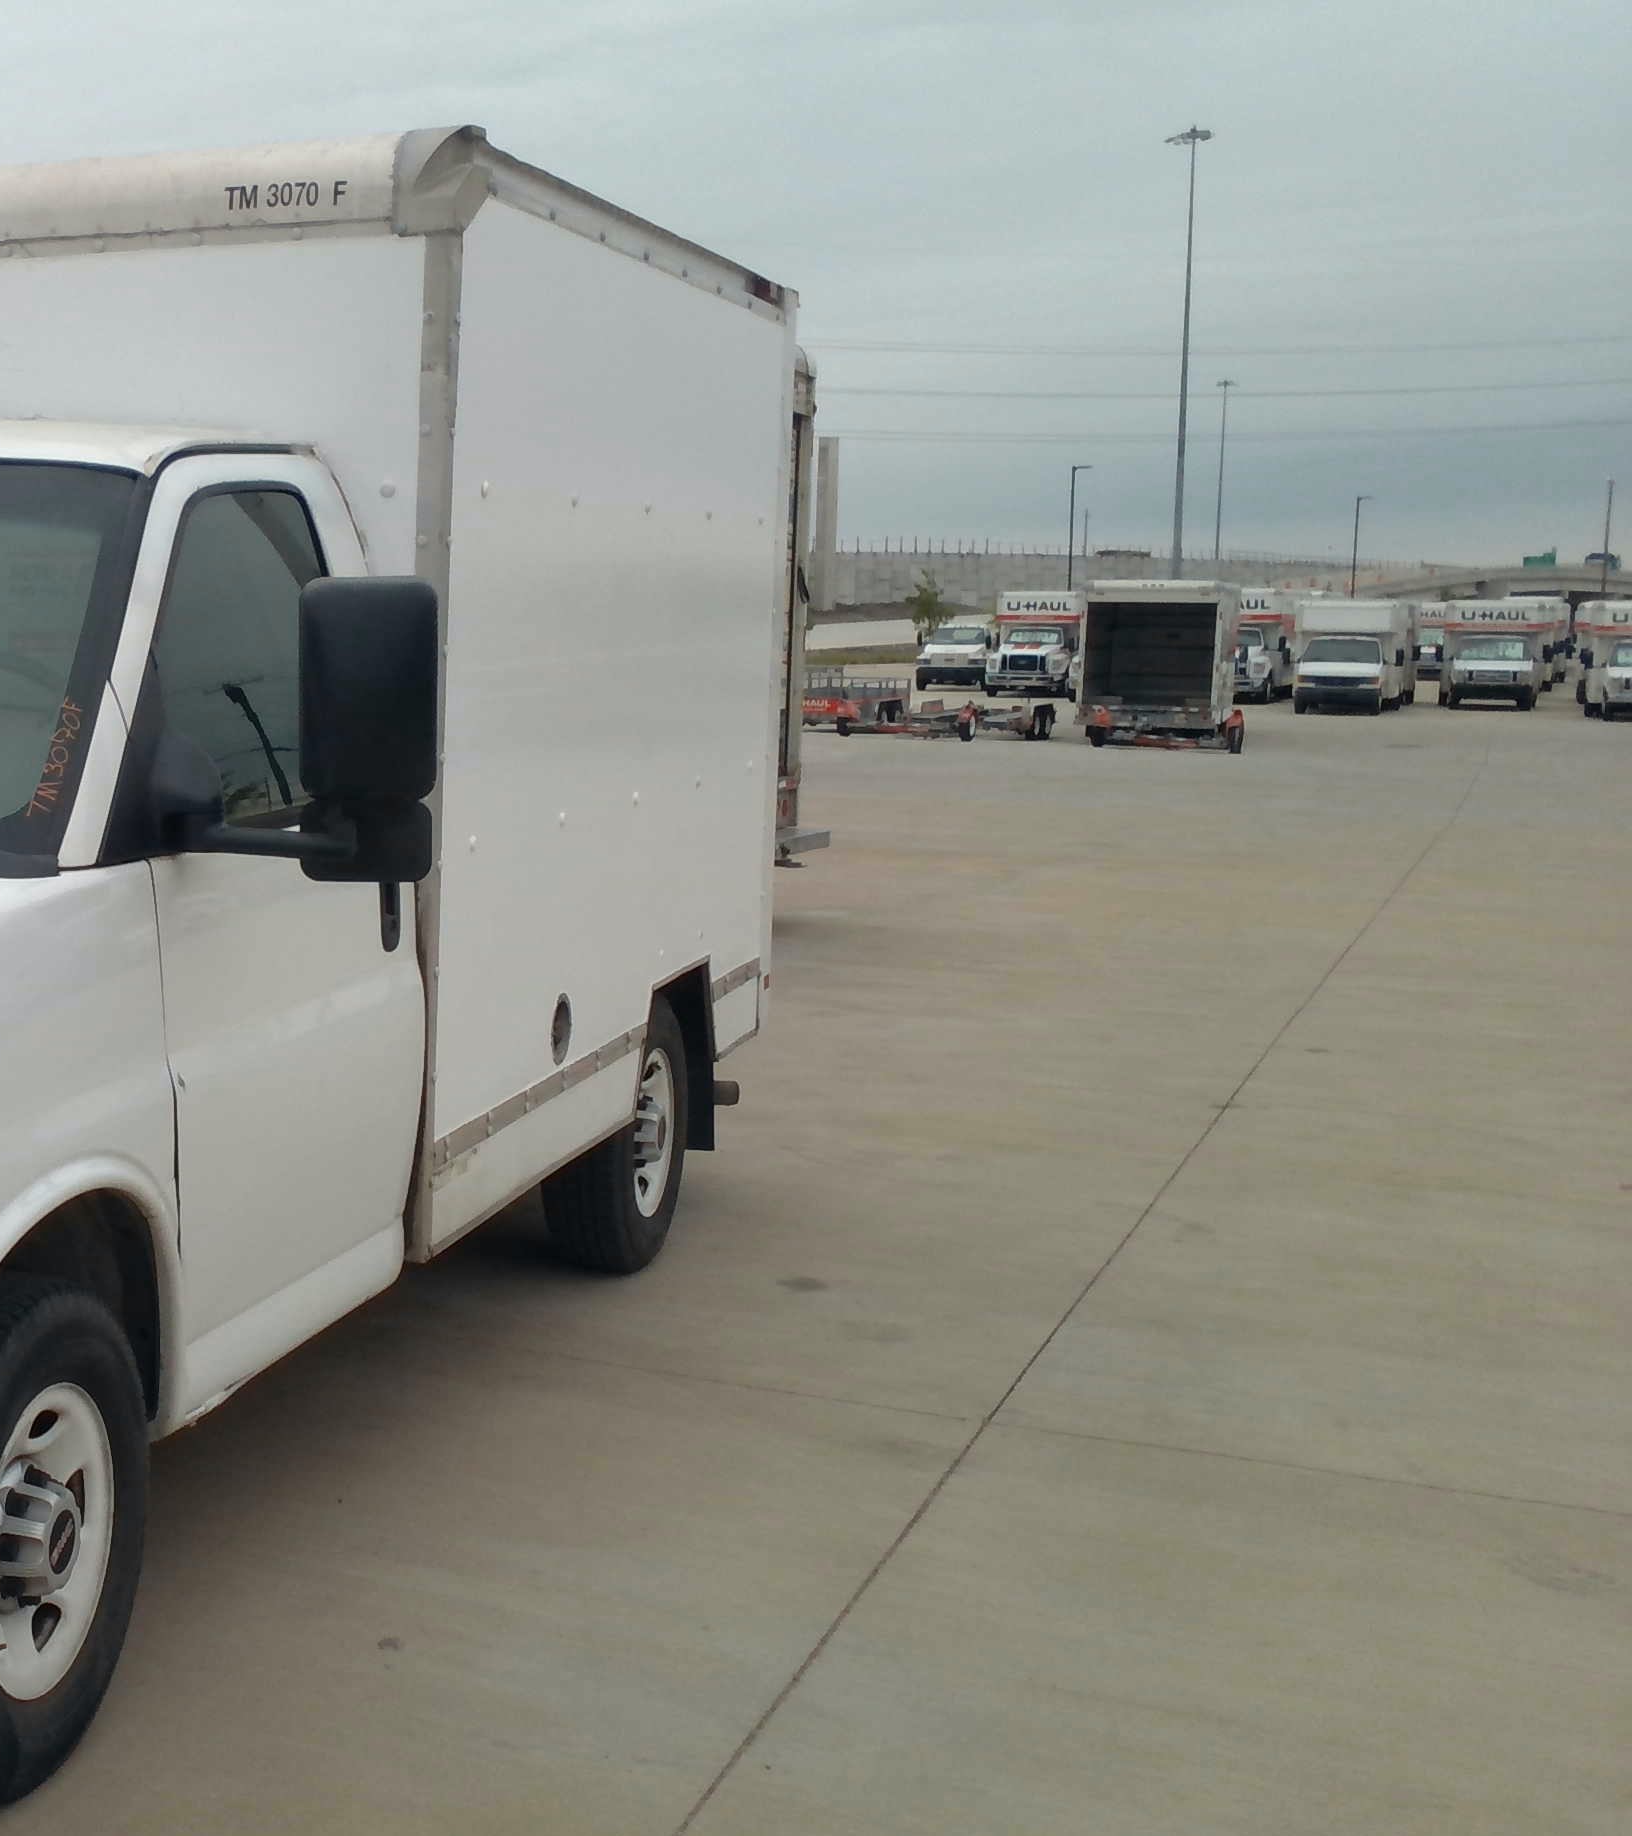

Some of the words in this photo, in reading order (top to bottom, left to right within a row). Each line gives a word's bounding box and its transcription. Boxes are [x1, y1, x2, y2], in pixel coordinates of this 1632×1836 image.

[224, 185, 259, 210] TM
[266, 182, 319, 207] 3070
[332, 180, 348, 206] F
[1006, 600, 1072, 612] U-HAUL
[1461, 610, 1530, 621] U-HAUL
